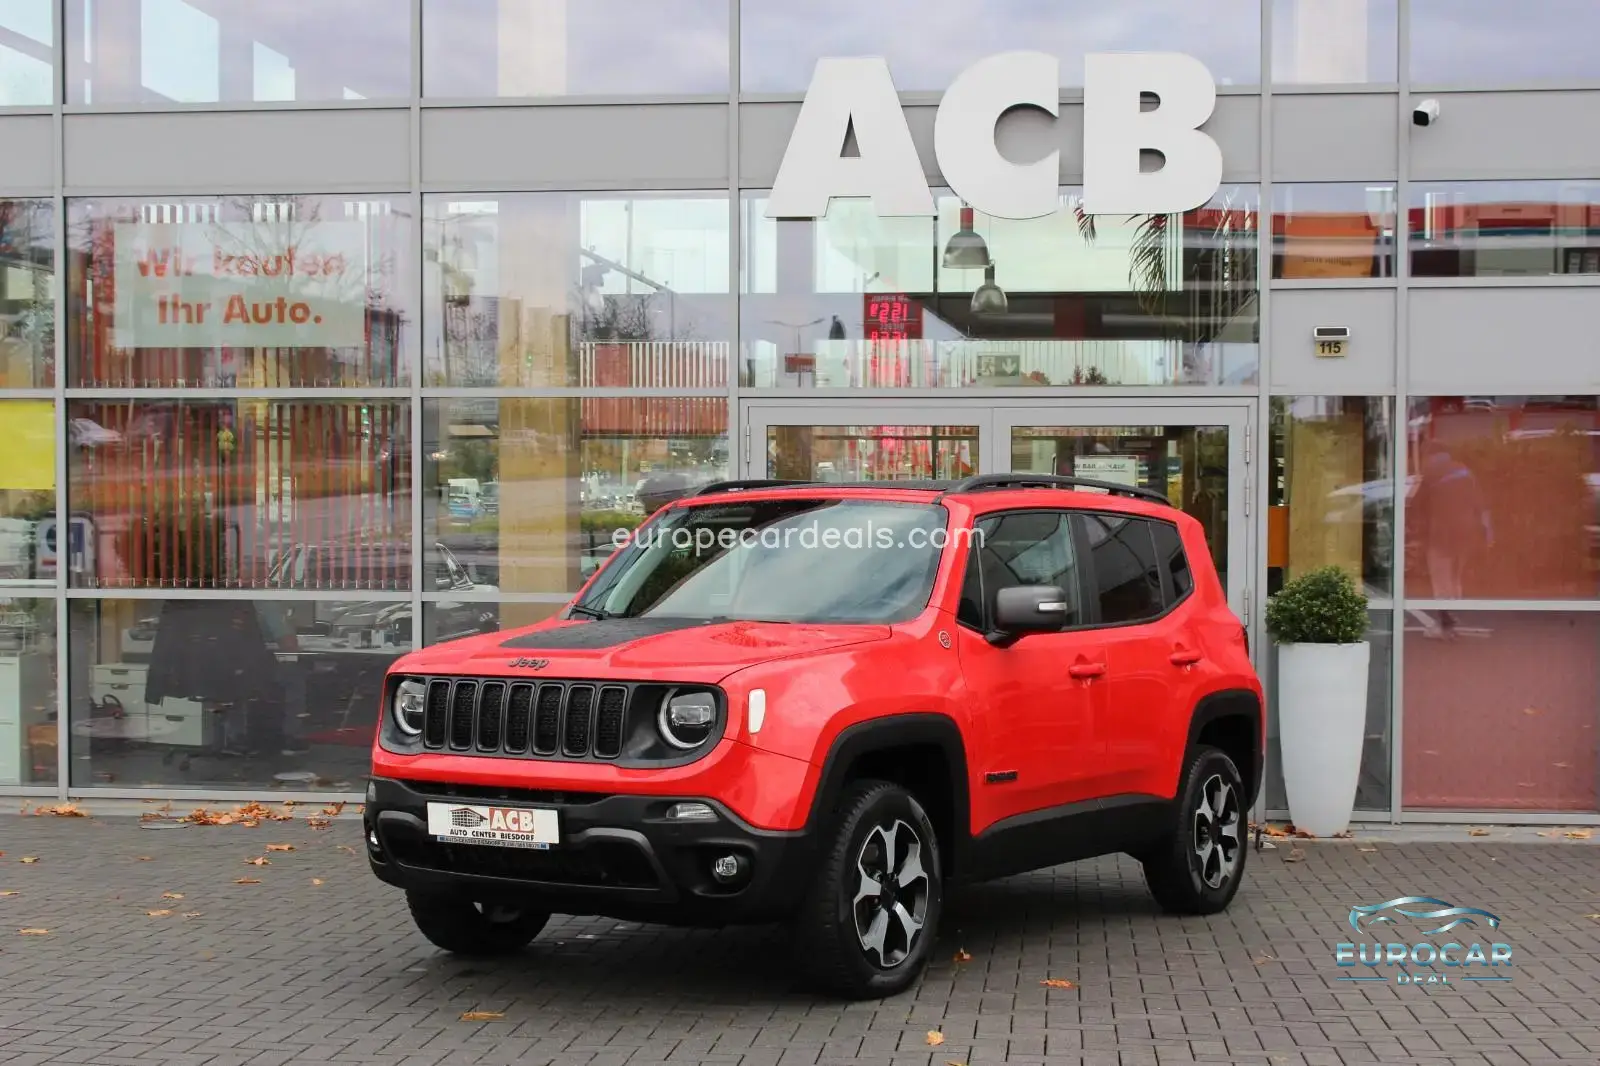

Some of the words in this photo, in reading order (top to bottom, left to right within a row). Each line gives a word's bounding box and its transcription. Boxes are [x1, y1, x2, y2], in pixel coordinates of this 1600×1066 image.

[764, 51, 1223, 220] ACB
[136, 247, 197, 278] Wir
[213, 245, 345, 278] kaufen
[158, 293, 211, 324] Ihr
[223, 294, 323, 324] Auto.
[1319, 340, 1342, 354] 115
[508, 657, 549, 671] Jeep
[491, 809, 534, 832] ACB
[449, 828, 468, 837] AUTO
[471, 830, 497, 839] CENTER
[500, 832, 535, 841] BIESDORF
